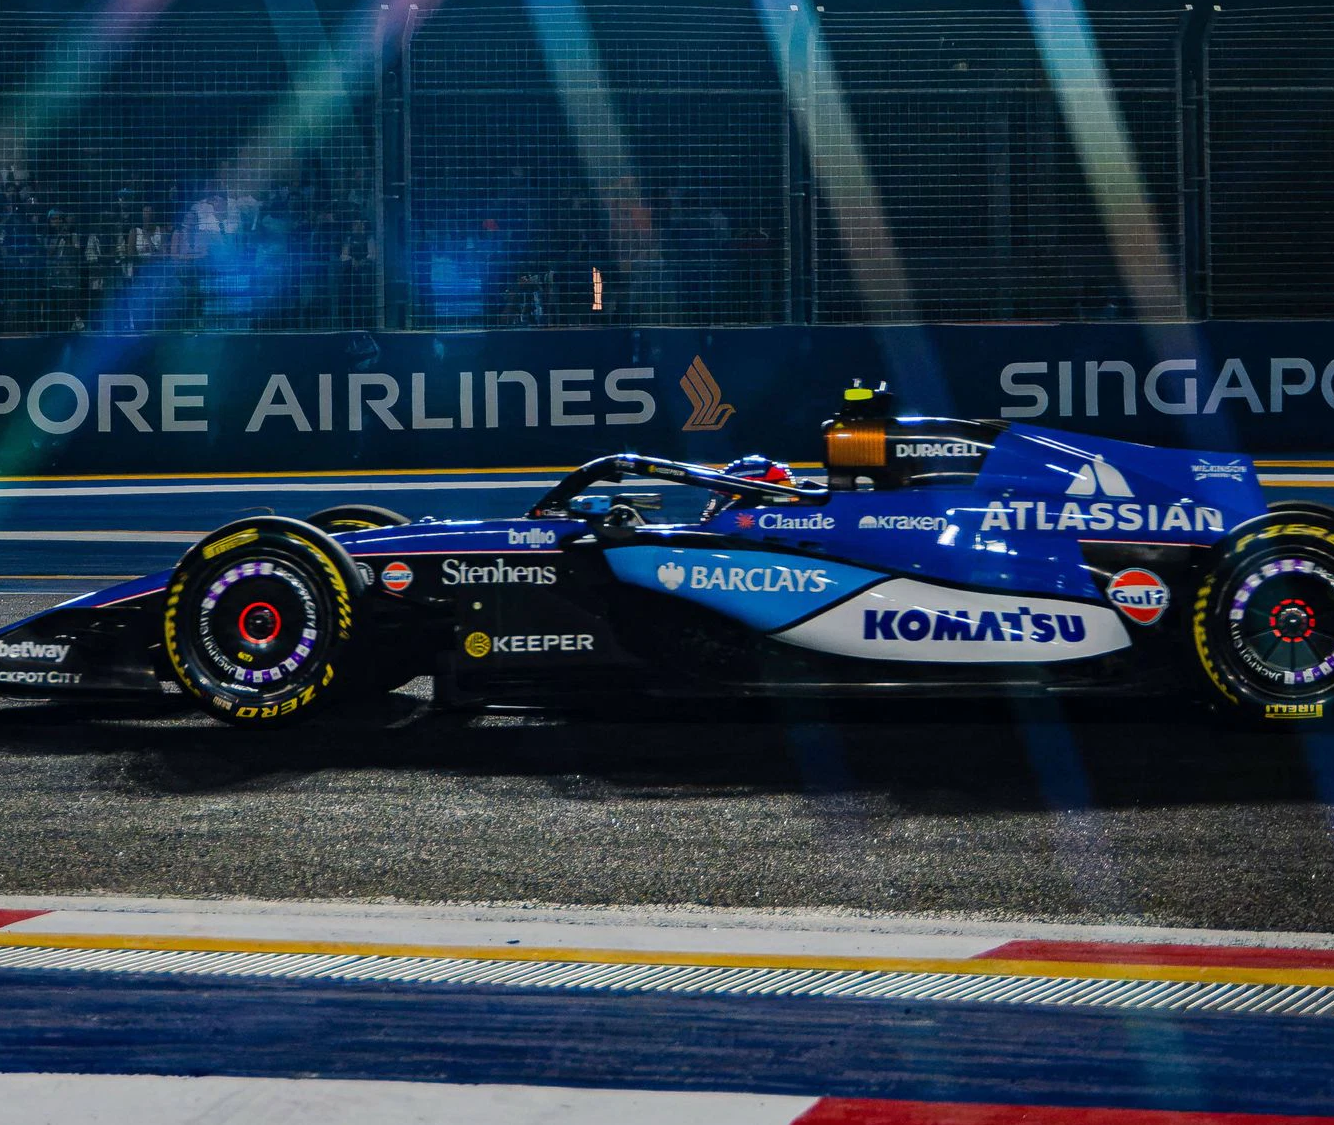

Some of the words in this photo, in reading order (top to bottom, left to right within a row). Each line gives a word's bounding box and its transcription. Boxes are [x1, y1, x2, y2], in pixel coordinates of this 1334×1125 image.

[246, 367, 656, 432] AIRLINES
[895, 443, 982, 458] DURACELL
[758, 513, 835, 530] Claude
[979, 500, 1225, 532] ATLASSIAN
[441, 558, 557, 585] Stephens
[690, 566, 828, 593] BARCLAYS
[1112, 589, 1166, 605] Gulf
[863, 607, 1087, 643] KOMATSU
[493, 634, 594, 652] KEEPER
[235, 685, 317, 719] ZERO
[1265, 703, 1324, 719] PIRELLI
